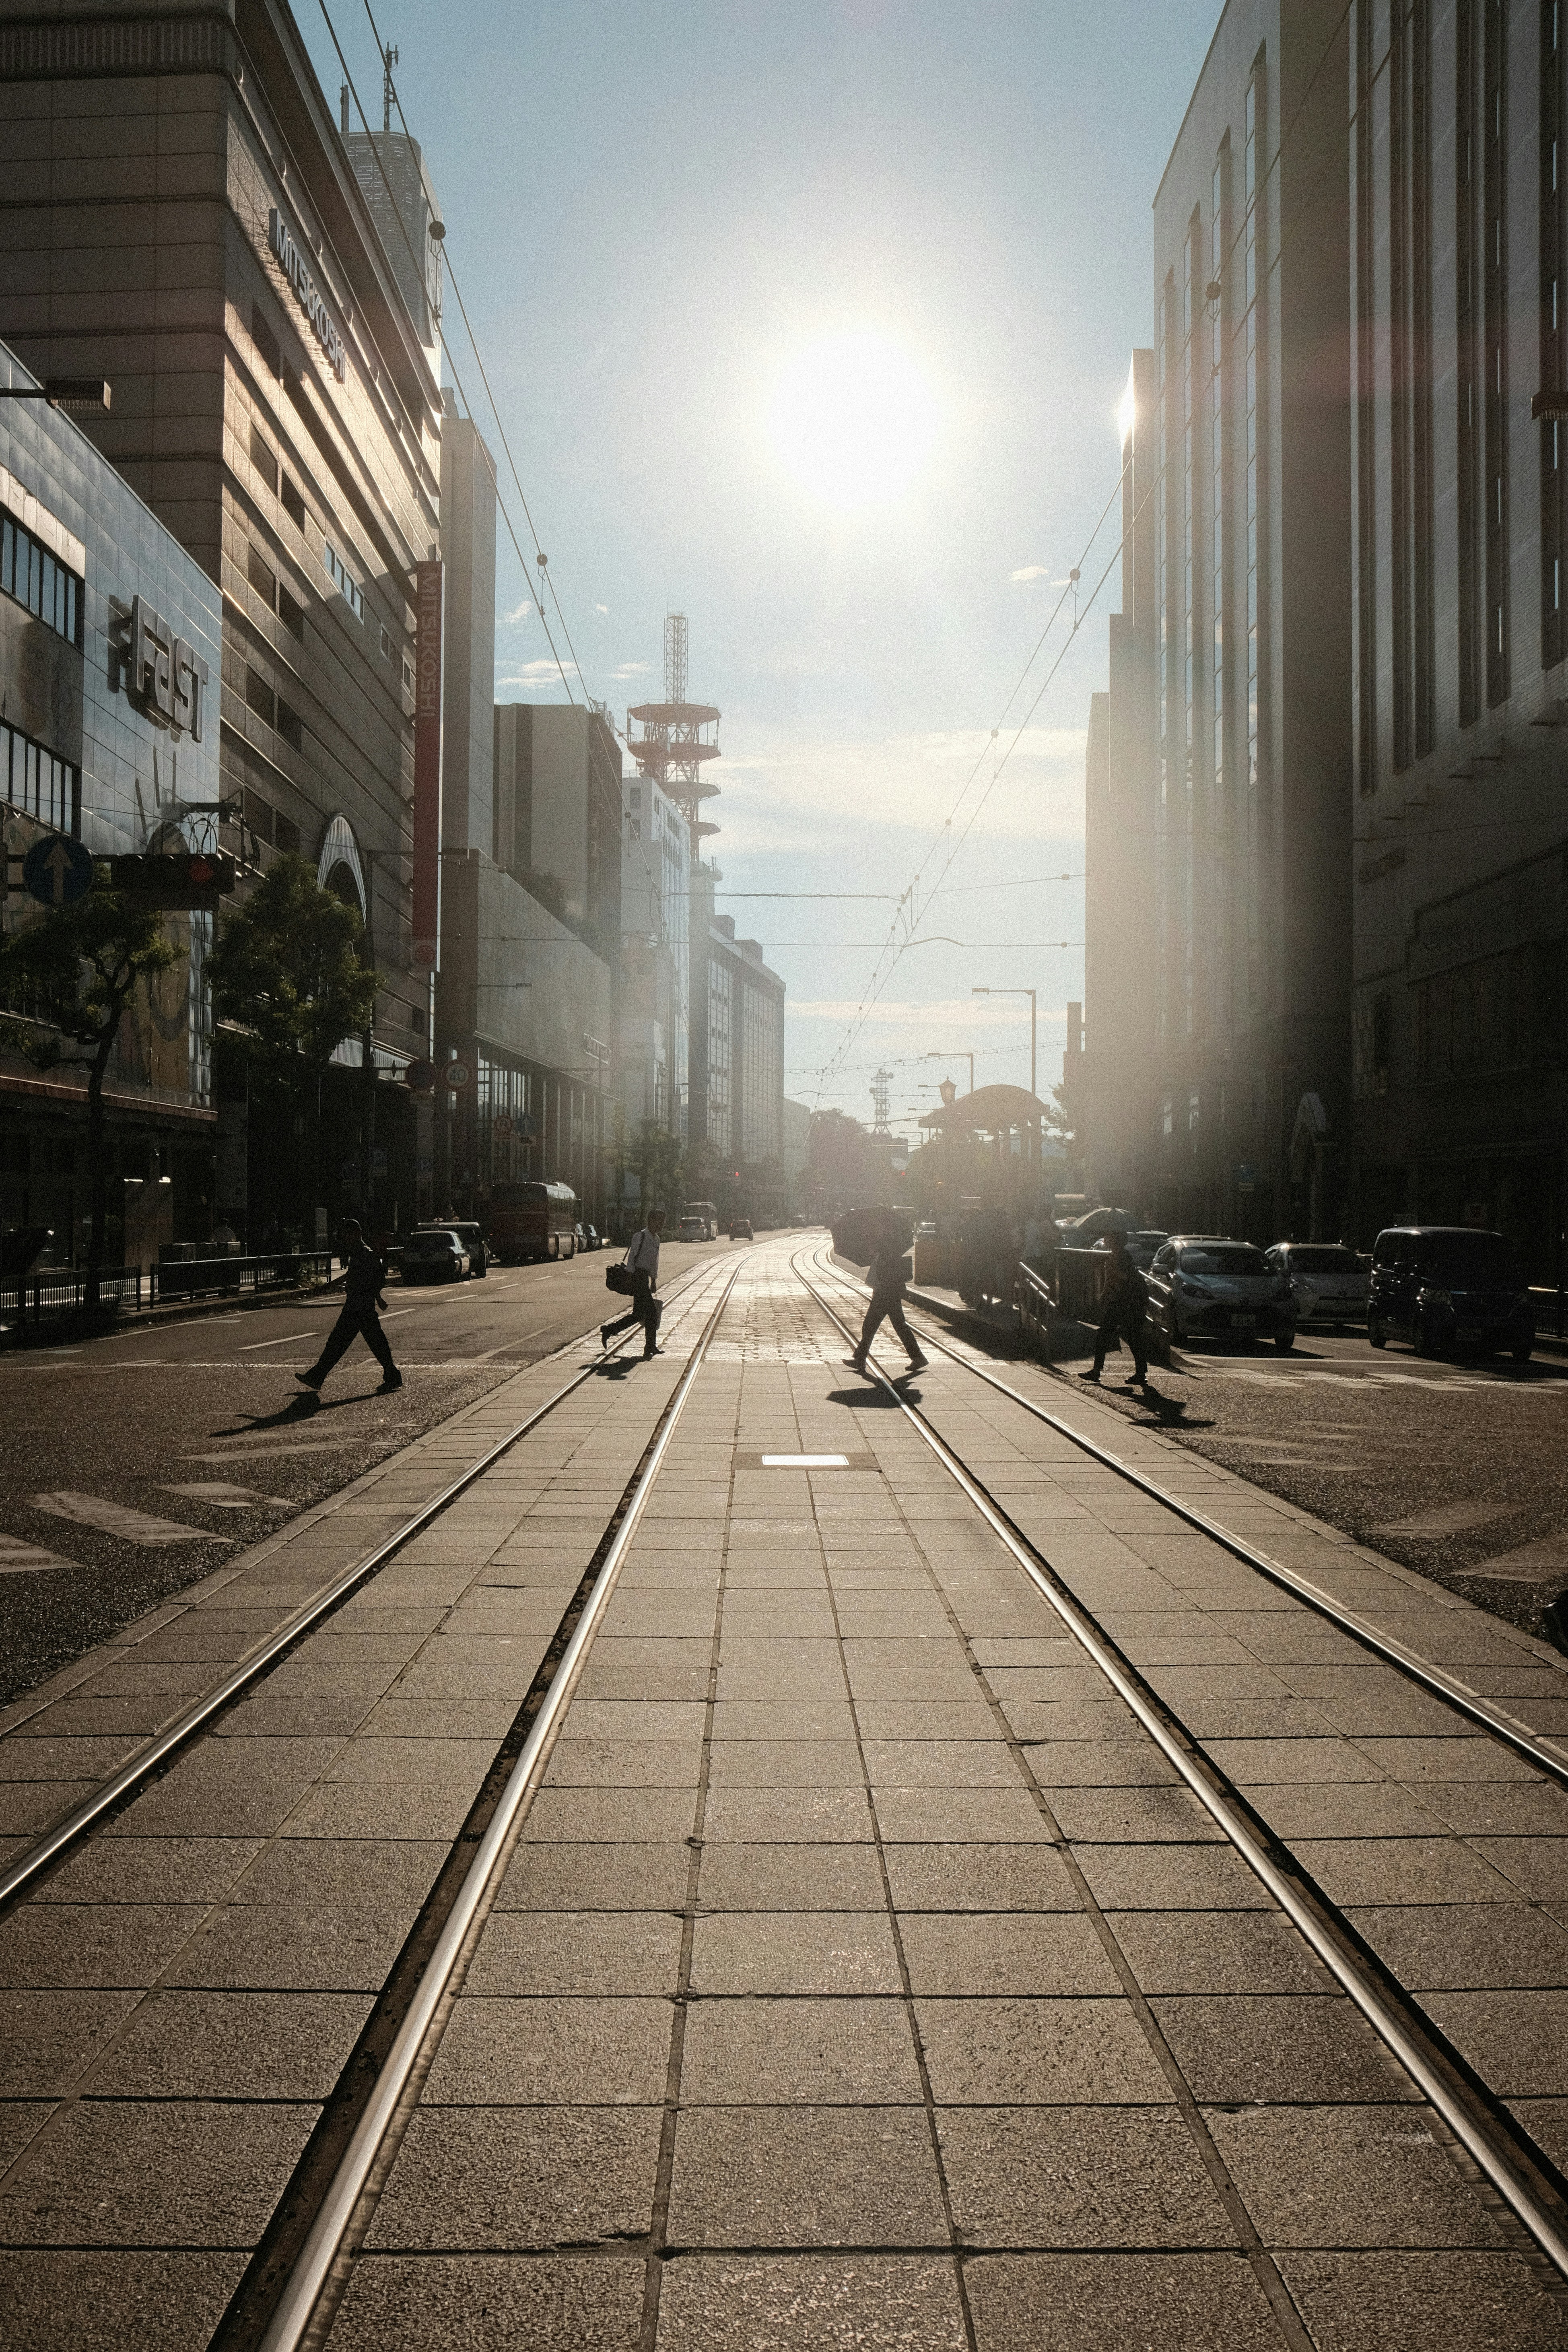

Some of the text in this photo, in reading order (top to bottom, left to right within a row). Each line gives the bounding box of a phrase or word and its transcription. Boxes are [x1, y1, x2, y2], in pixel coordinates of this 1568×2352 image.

[270, 208, 346, 384] MITSUKOSHI
[419, 572, 438, 718] MITSUKOSHI
[449, 1068, 466, 1082] 40
[373, 1150, 383, 1165] P
[420, 1159, 430, 1171] P
